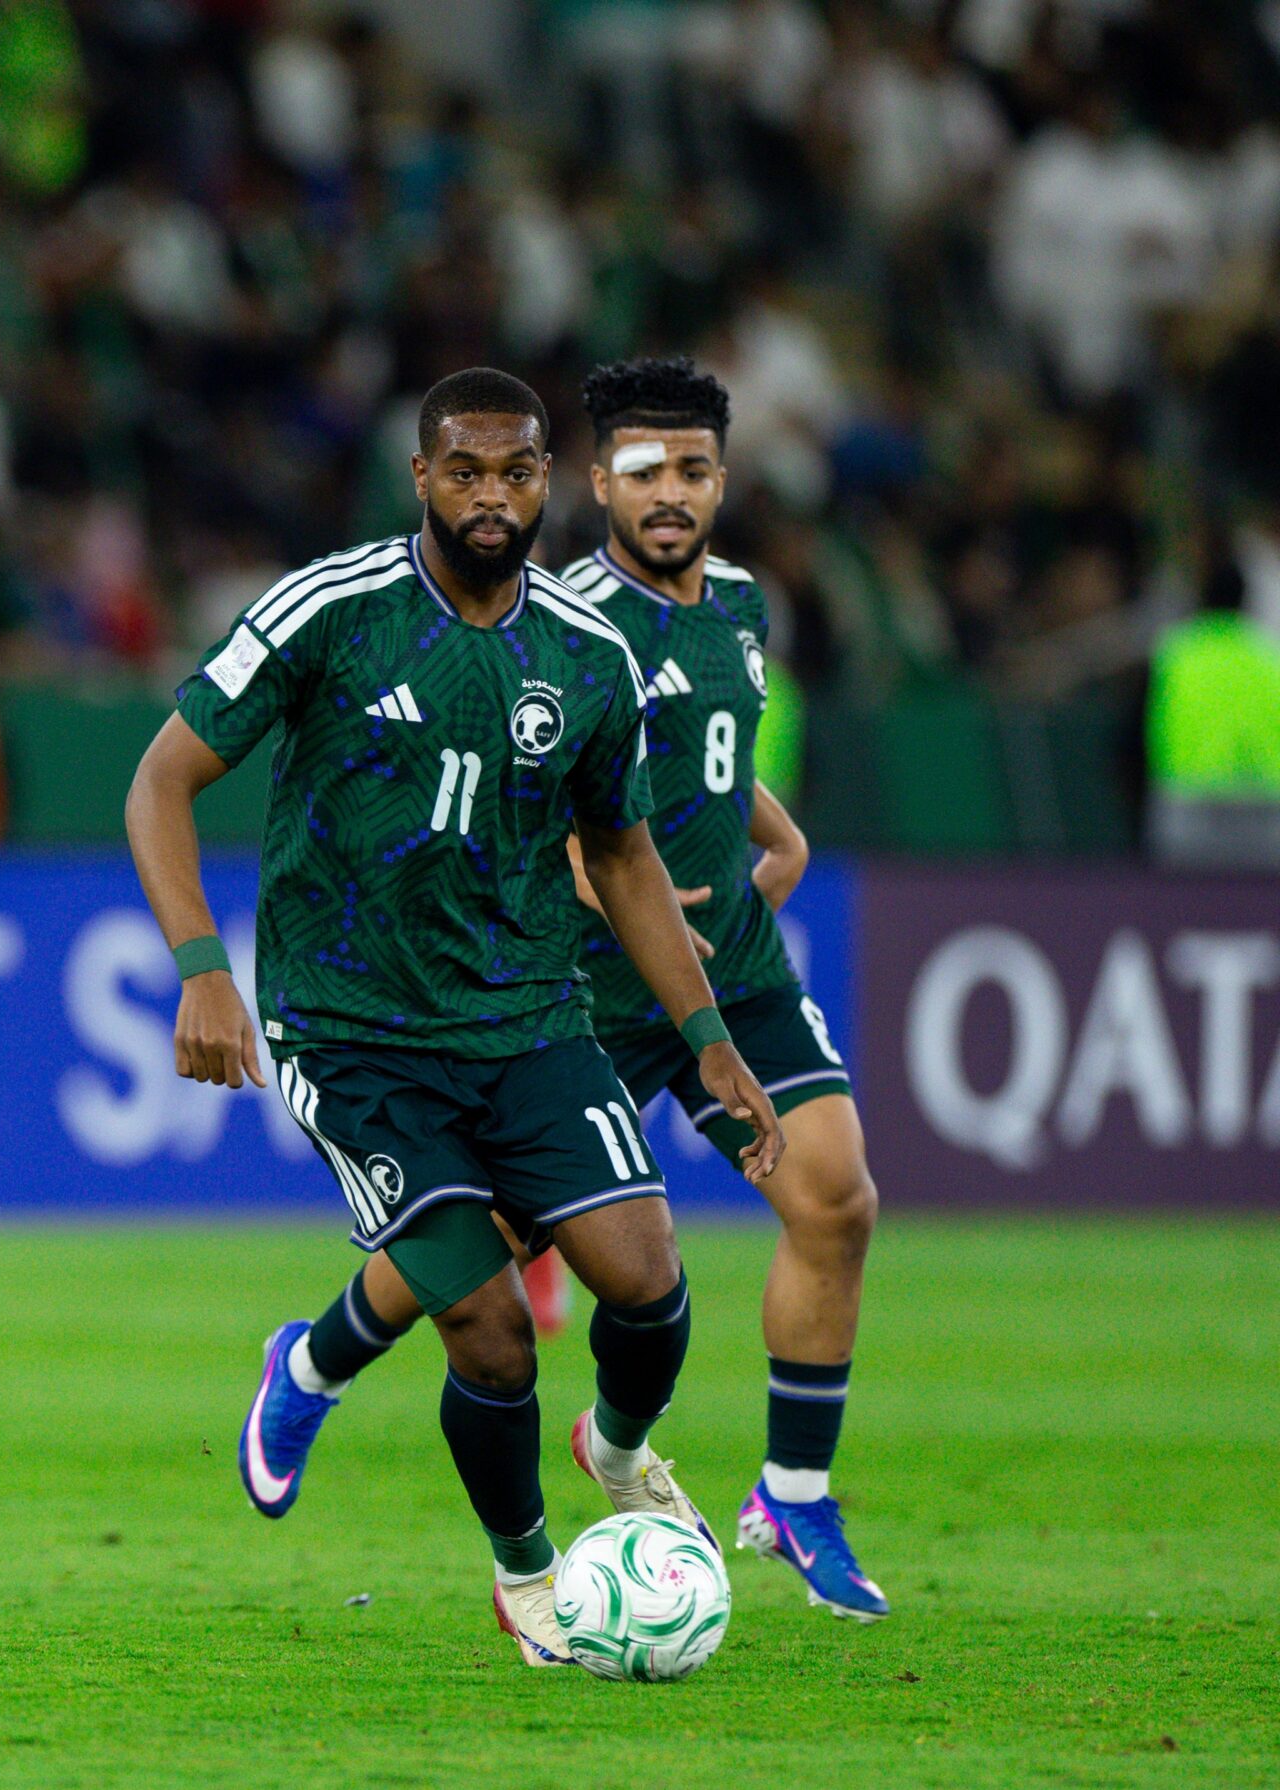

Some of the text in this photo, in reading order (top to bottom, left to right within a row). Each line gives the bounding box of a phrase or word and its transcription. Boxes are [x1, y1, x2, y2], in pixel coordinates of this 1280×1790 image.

[521, 679, 564, 697] السعودية
[430, 748, 482, 836] 11
[512, 756, 542, 768] SAUDI
[704, 710, 737, 794] 8
[903, 924, 1280, 1172] QAT
[584, 1101, 650, 1180] 11
